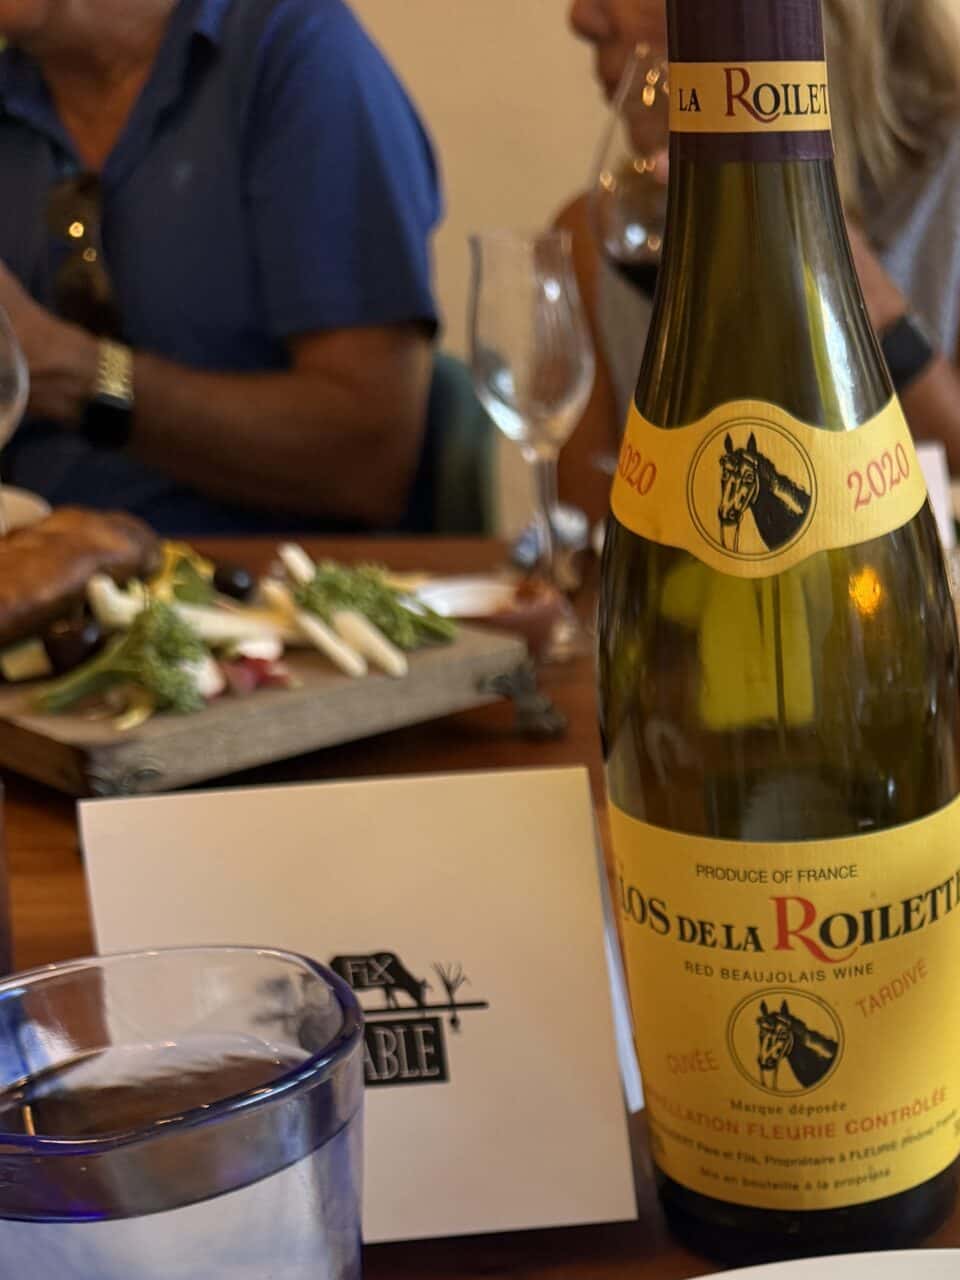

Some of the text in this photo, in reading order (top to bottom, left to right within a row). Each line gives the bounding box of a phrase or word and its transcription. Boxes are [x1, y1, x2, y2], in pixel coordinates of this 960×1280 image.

[678, 66, 828, 123] LA ROILET
[618, 443, 657, 497] 020
[846, 441, 911, 512] 2020
[695, 863, 859, 884] PRODUCE OF FRANCE
[619, 874, 672, 936] LOS
[677, 915, 718, 949] DE
[722, 923, 766, 952] LA
[684, 960, 874, 984] RED BEAUJOLAIS WINE
[855, 957, 929, 1019] TARDIVE
[363, 1023, 441, 1081] ABLE
[730, 1099, 784, 1116] Marque
[747, 1123, 838, 1141] FLEURIE
[844, 1086, 948, 1136] CONTRÔLÉE
